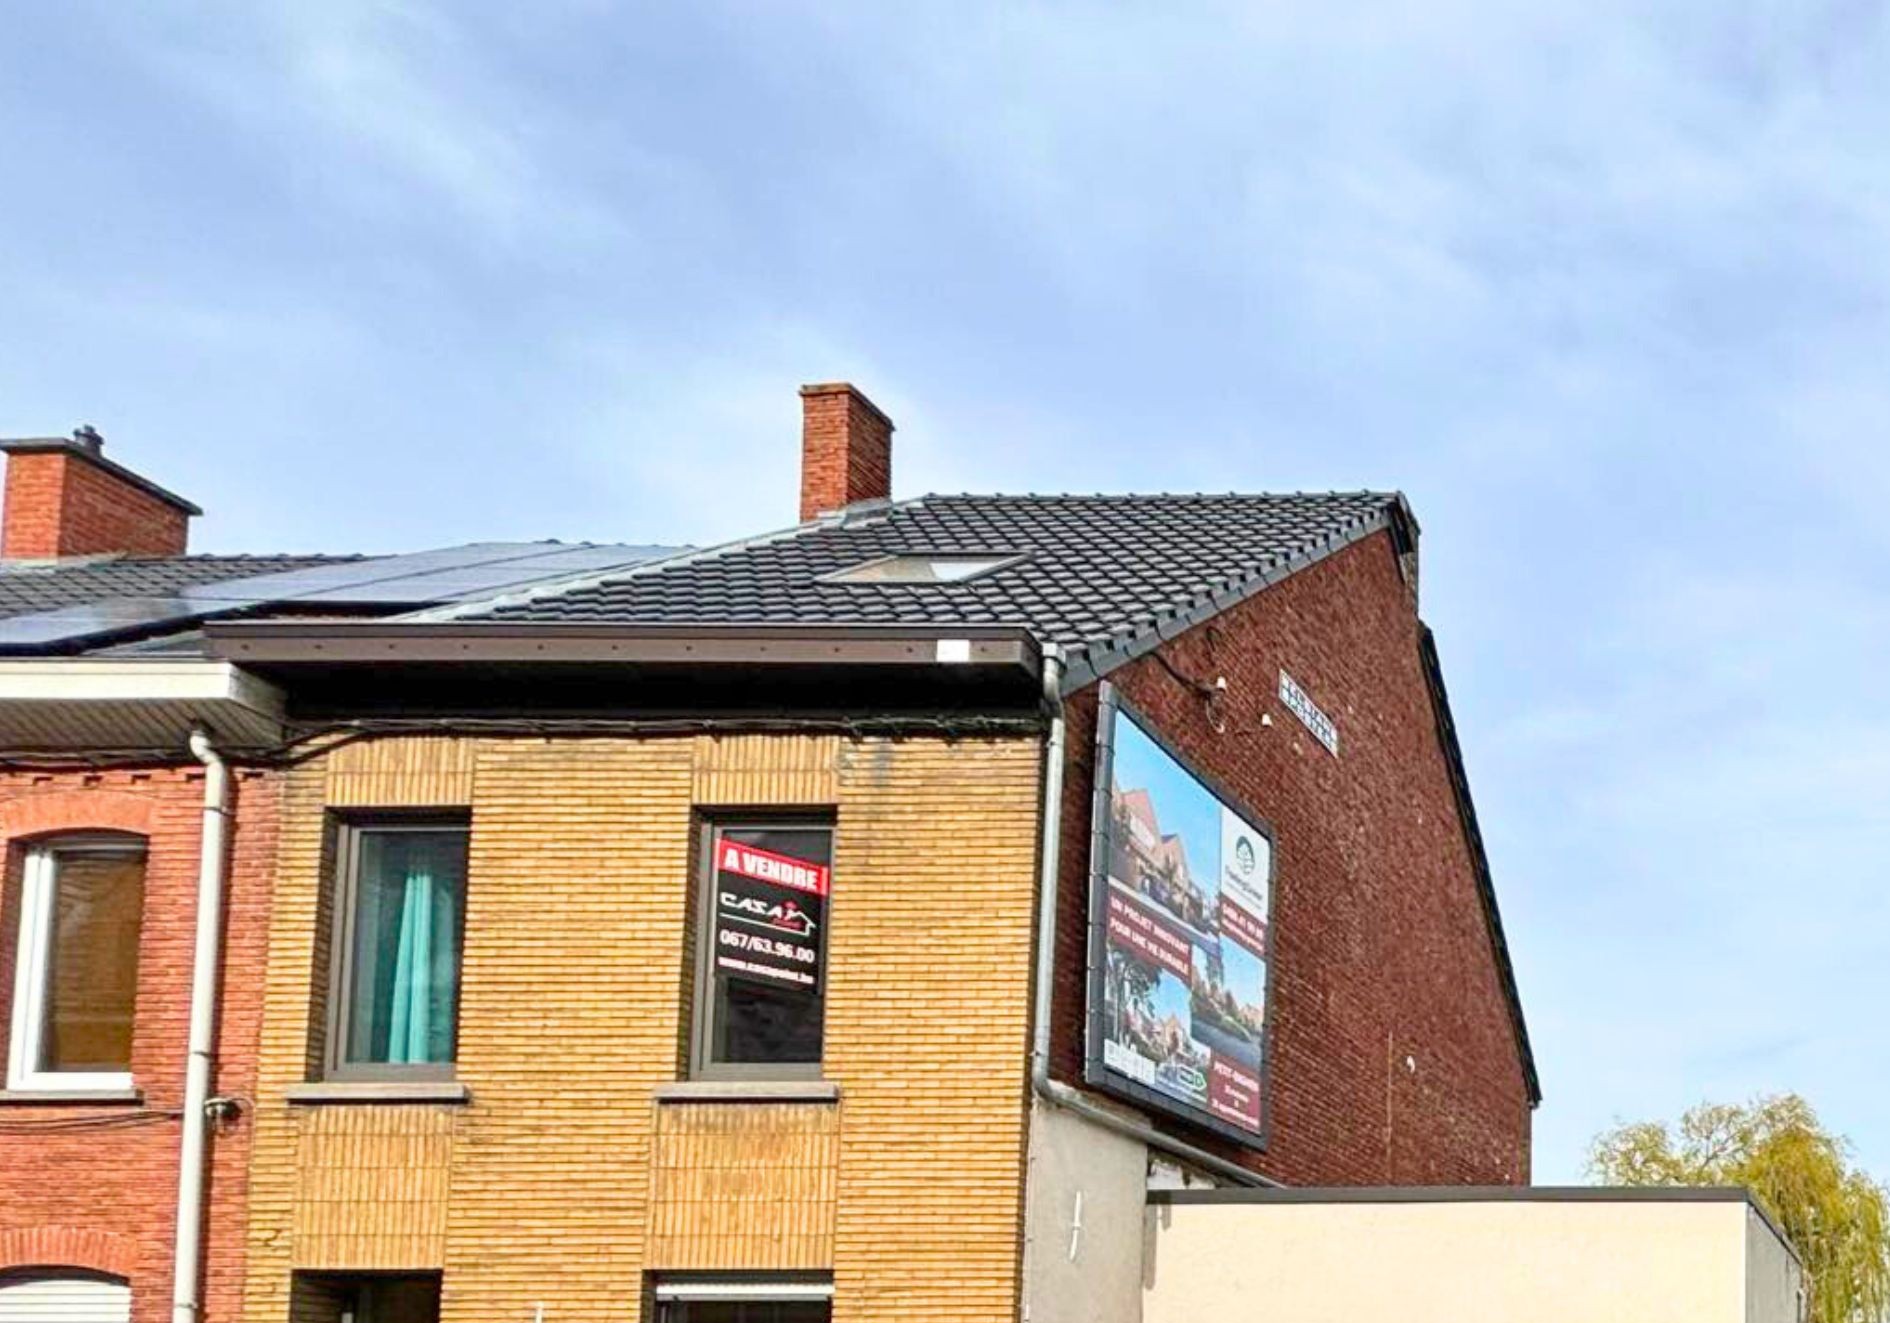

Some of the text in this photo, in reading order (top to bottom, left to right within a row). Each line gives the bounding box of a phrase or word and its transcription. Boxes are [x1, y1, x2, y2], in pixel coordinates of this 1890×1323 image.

[724, 848, 817, 890] A VENDRE
[720, 892, 782, 919] CASA
[720, 930, 816, 963] 067/63.96.00
